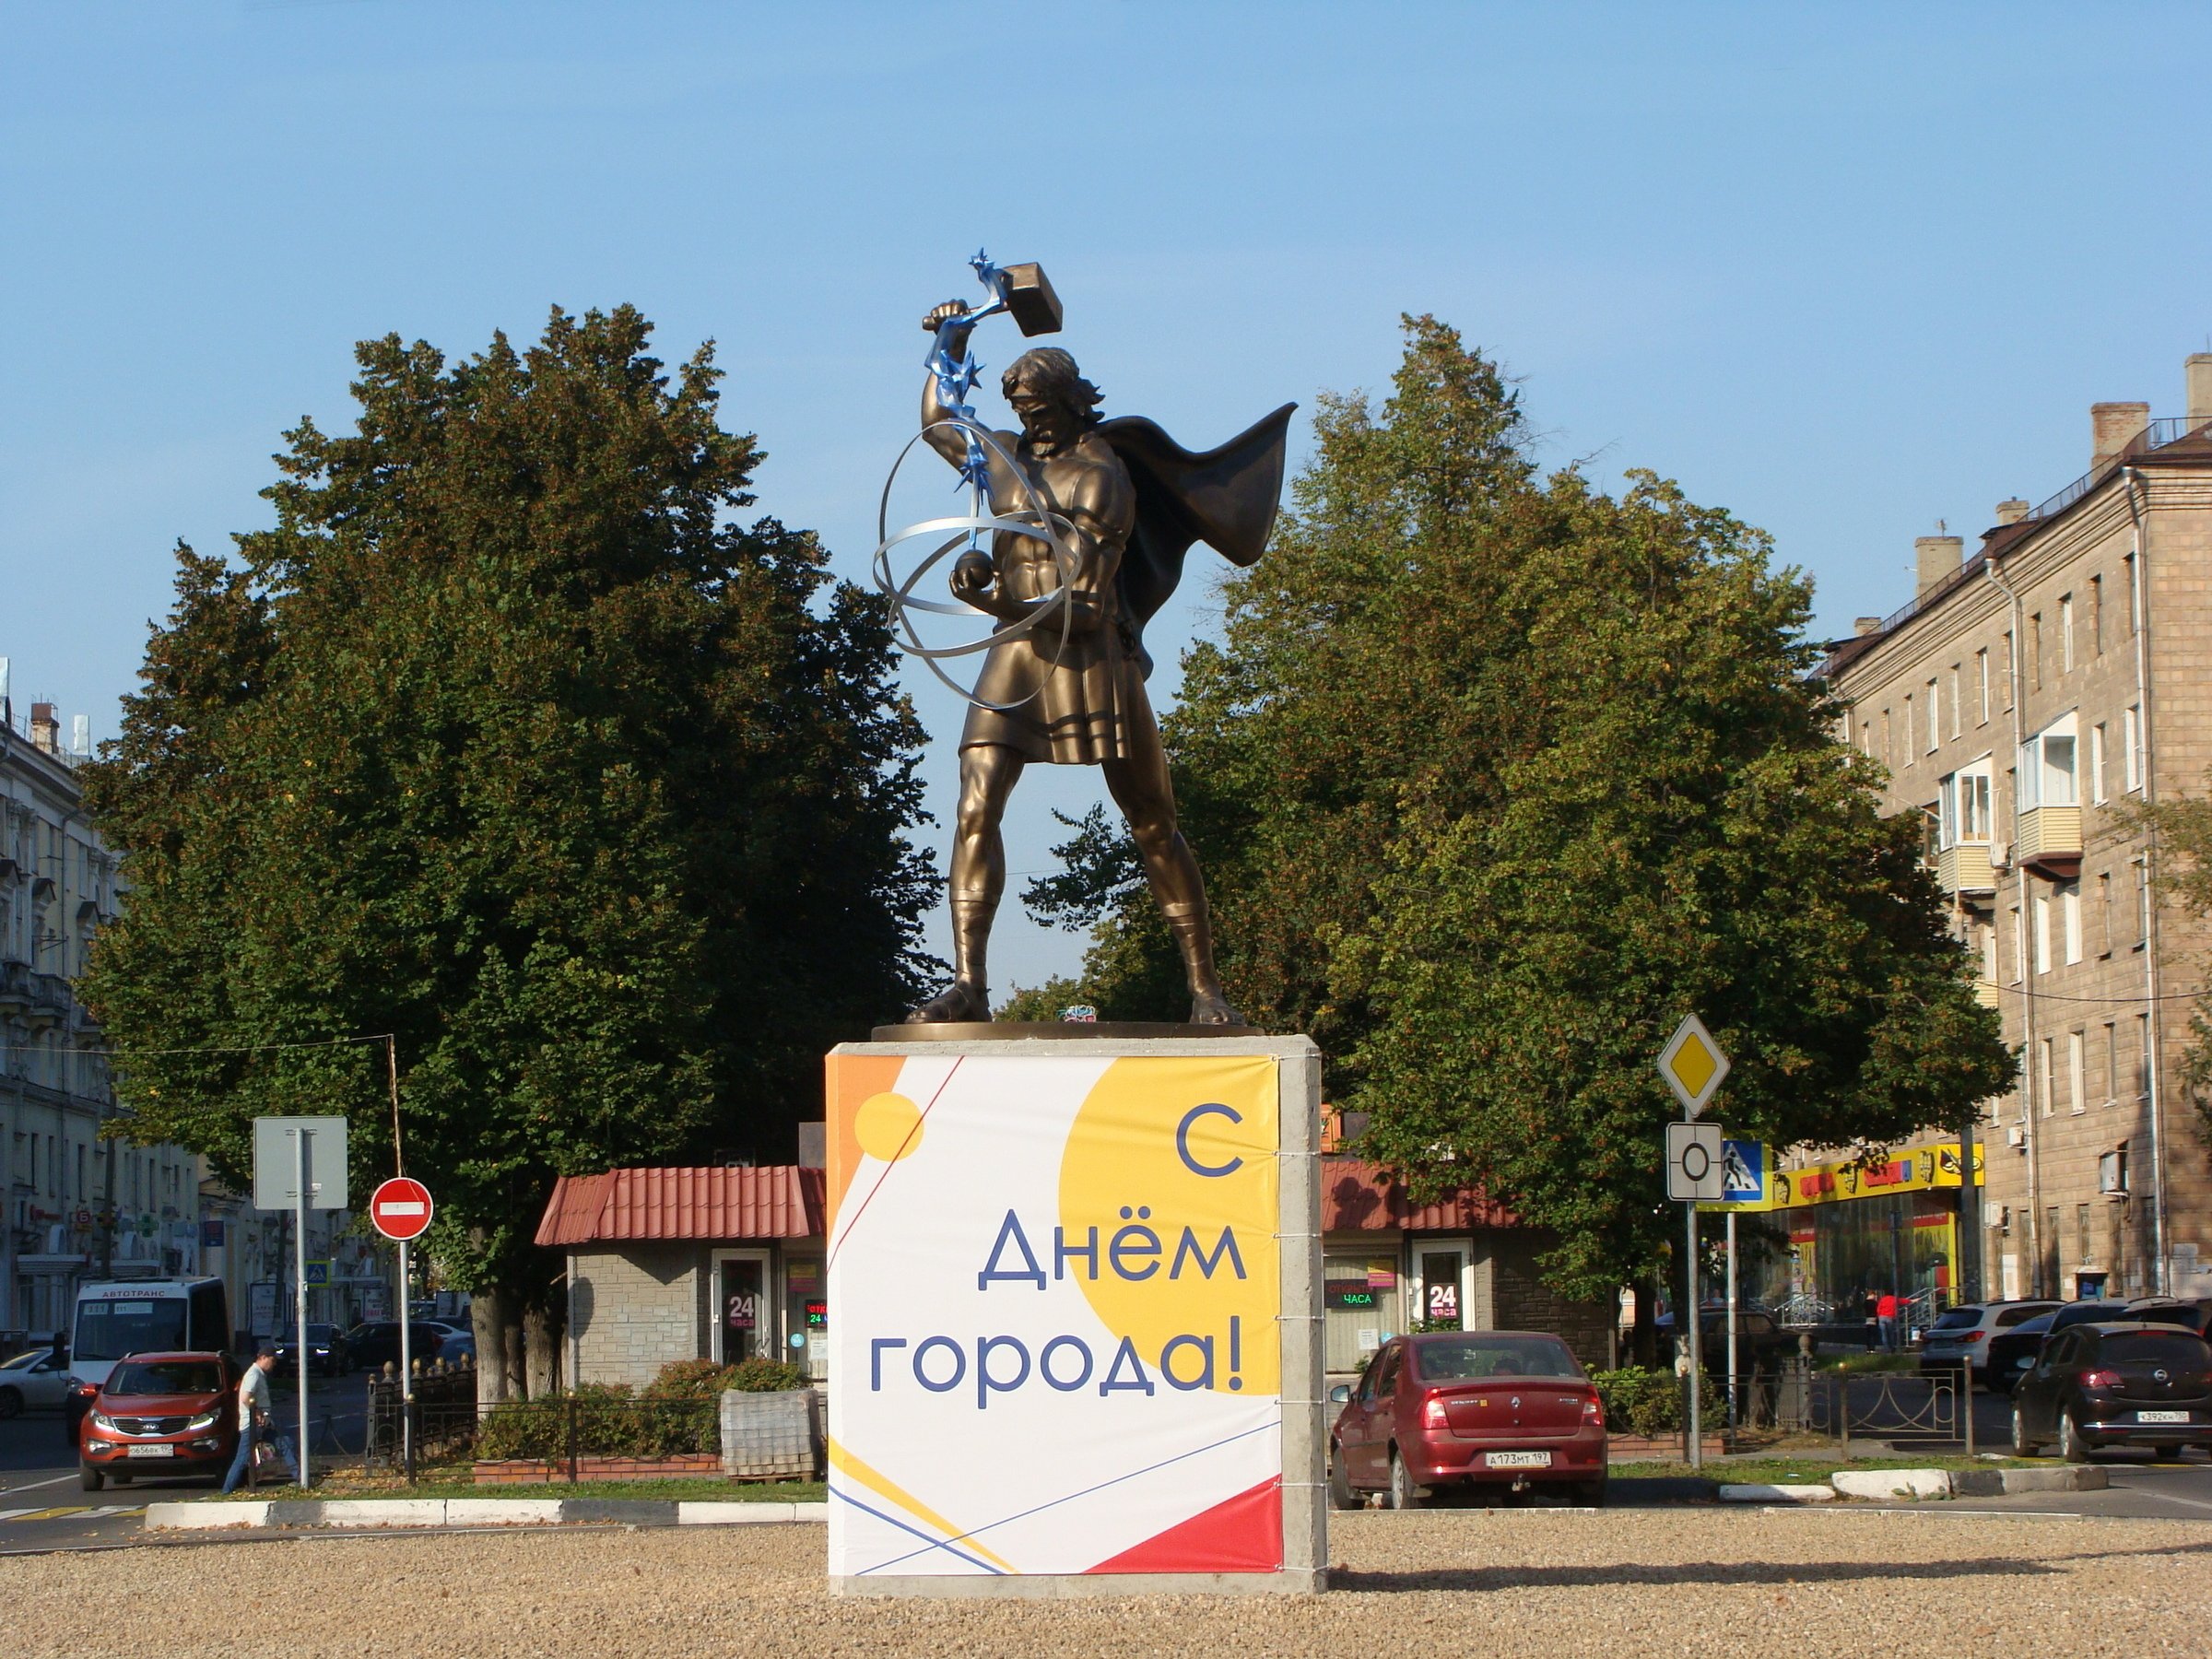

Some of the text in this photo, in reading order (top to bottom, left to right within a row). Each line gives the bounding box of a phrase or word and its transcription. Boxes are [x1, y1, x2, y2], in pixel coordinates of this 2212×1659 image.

[1176, 1102, 1243, 1177] С
[978, 1206, 1247, 1291] Днём
[729, 1296, 754, 1318] 24
[1343, 1294, 1372, 1304] ЧАСА
[1430, 1286, 1456, 1308] 24
[730, 1318, 755, 1326] часа
[810, 1314, 821, 1323] 24
[1430, 1308, 1457, 1316] часа
[871, 1315, 1242, 1410] города!
